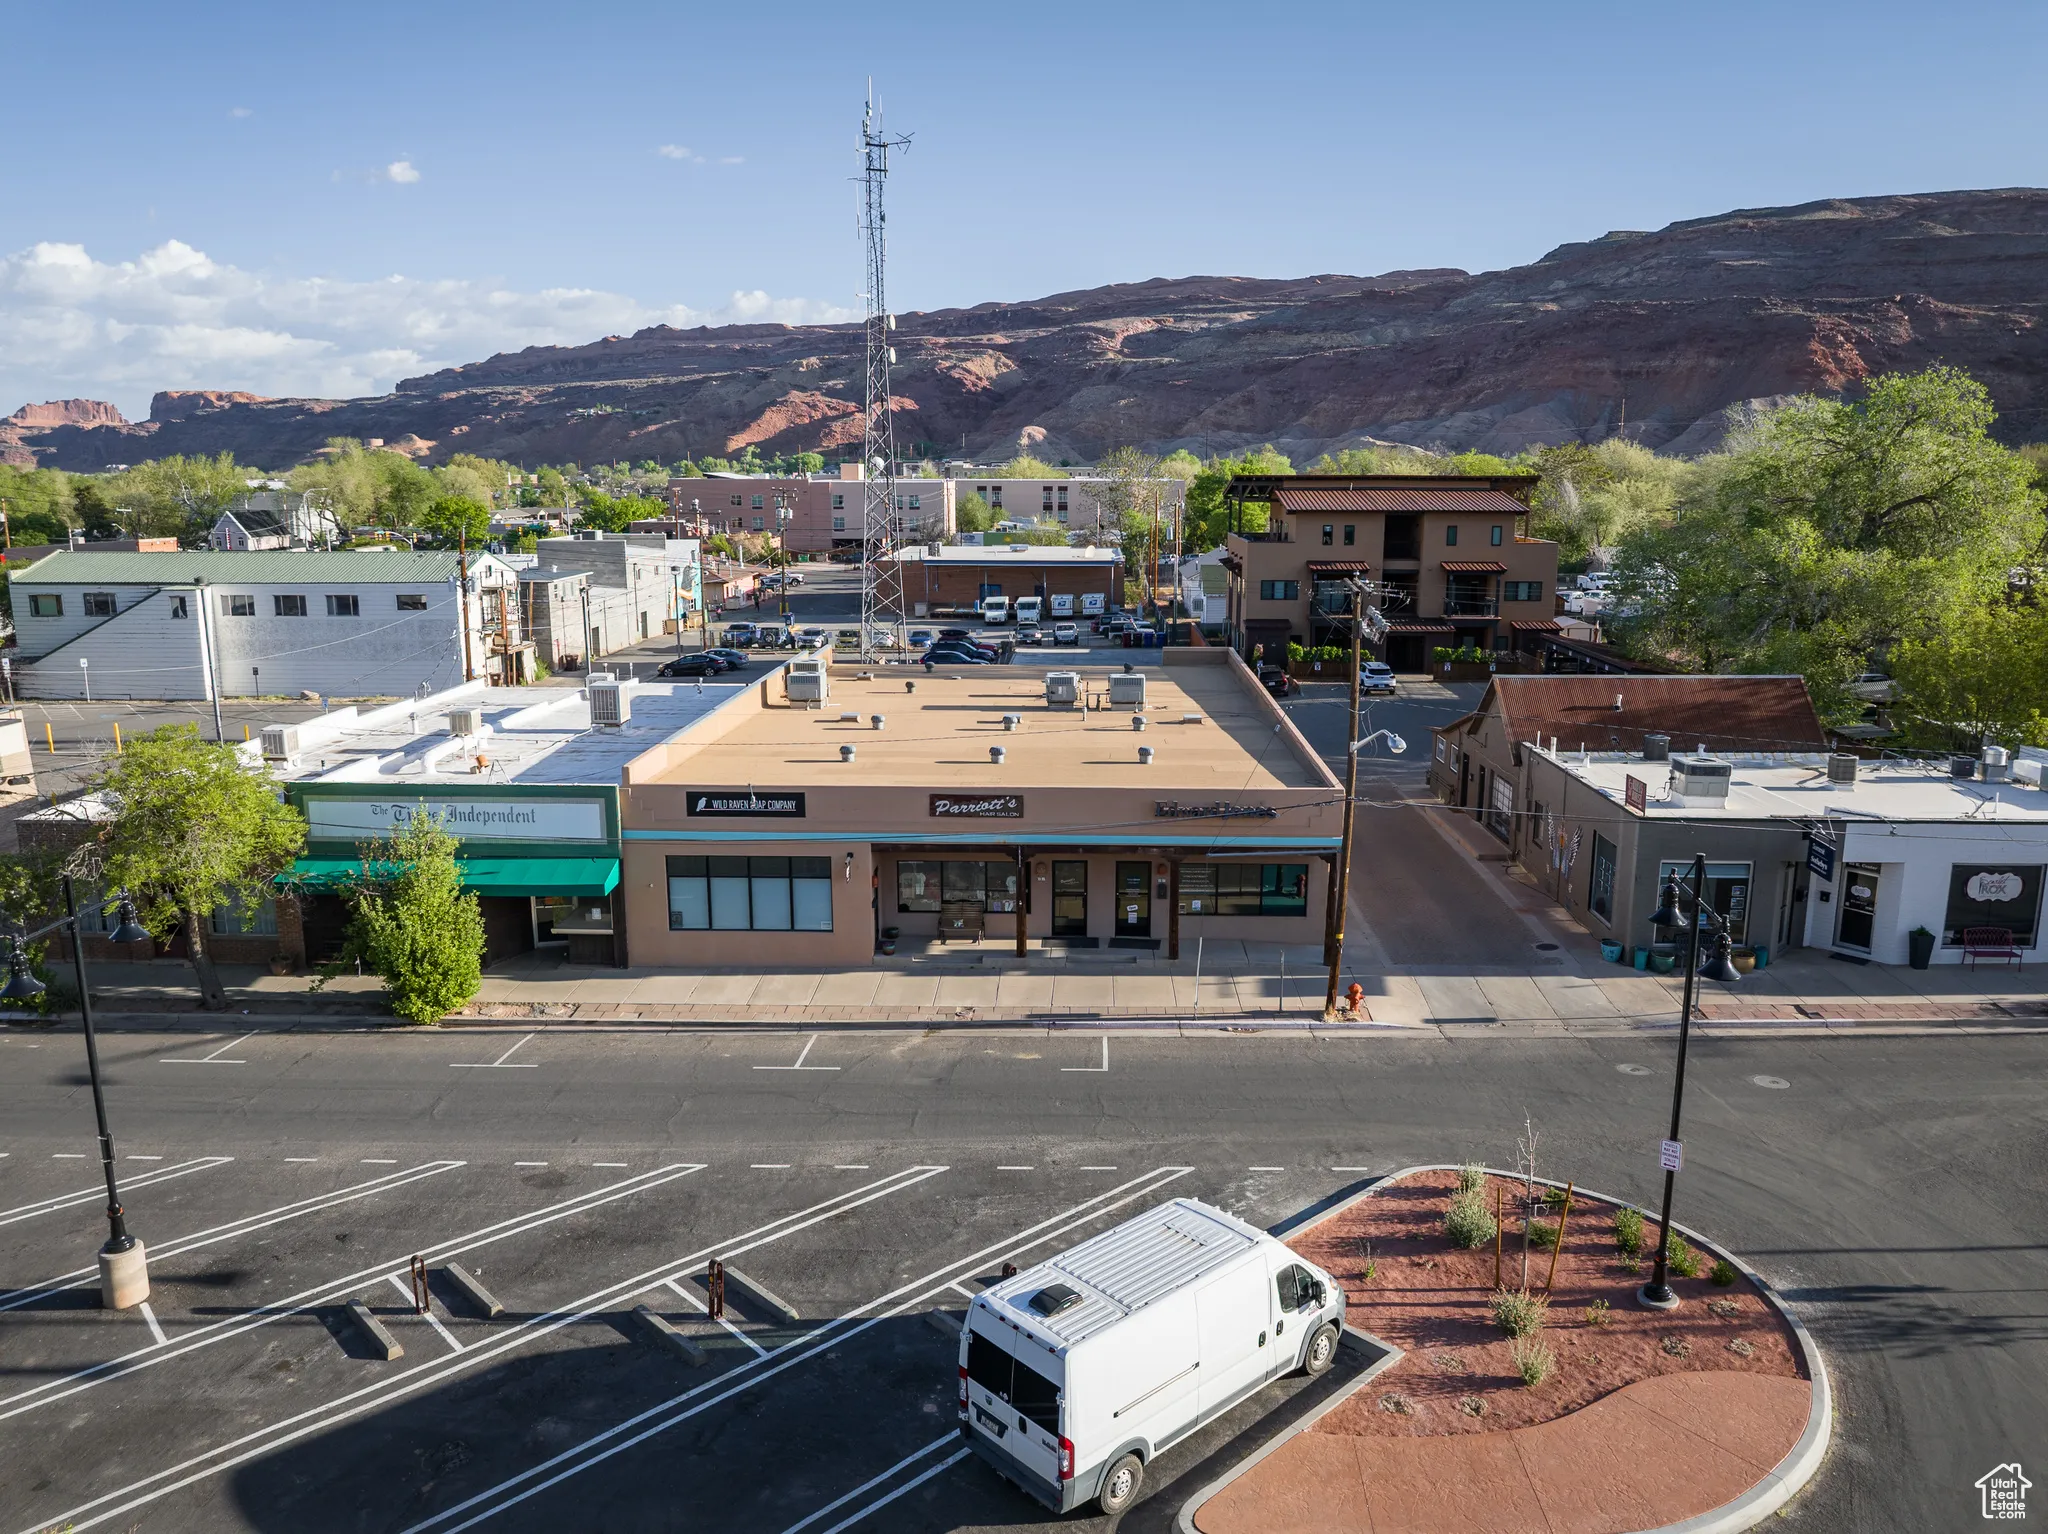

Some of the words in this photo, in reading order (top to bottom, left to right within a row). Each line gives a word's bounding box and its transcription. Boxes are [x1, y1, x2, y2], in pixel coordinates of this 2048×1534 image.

[370, 804, 388, 816] The
[391, 804, 439, 823] Ties
[446, 804, 536, 826] Independent
[712, 800, 727, 809] WILD
[729, 800, 748, 809] RAVEN
[768, 800, 796, 810] COMPANY
[935, 796, 1017, 816] Parriott's
